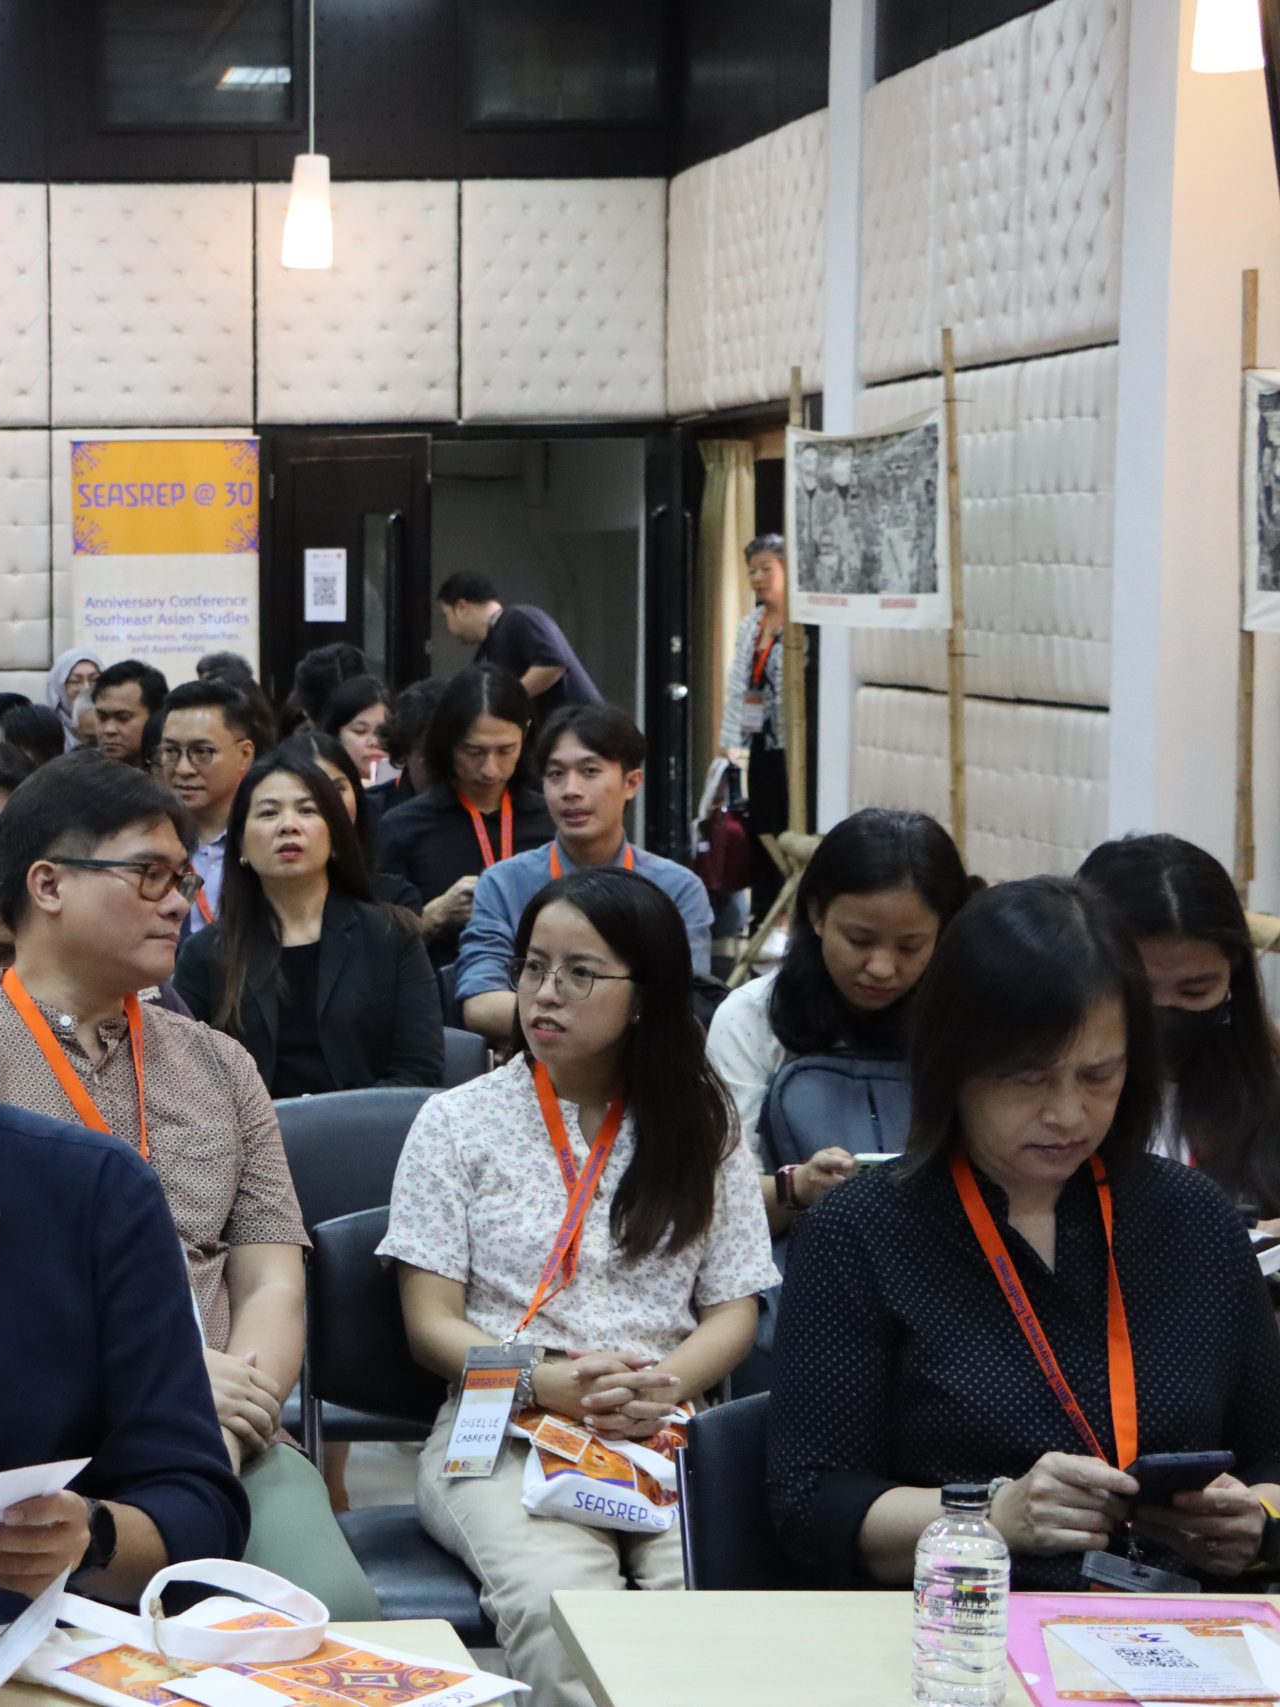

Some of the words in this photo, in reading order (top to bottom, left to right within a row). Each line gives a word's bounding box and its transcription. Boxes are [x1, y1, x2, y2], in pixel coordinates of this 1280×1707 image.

[78, 482, 185, 507] SEASREP
[194, 483, 216, 506] @
[224, 482, 253, 507] 30
[85, 597, 165, 609] Anniversary
[170, 595, 248, 608] Conference
[85, 614, 153, 627] Southeast
[158, 613, 195, 625] Asian
[200, 612, 249, 625] Studies
[995, 1255, 1028, 1315] Conference
[1023, 1316, 1058, 1379] Anniversary
[1055, 1380, 1073, 1407] 30th
[460, 1417, 501, 1429] GISELLE
[456, 1433, 497, 1444] CABRERA
[574, 1491, 648, 1523] SEASREP
